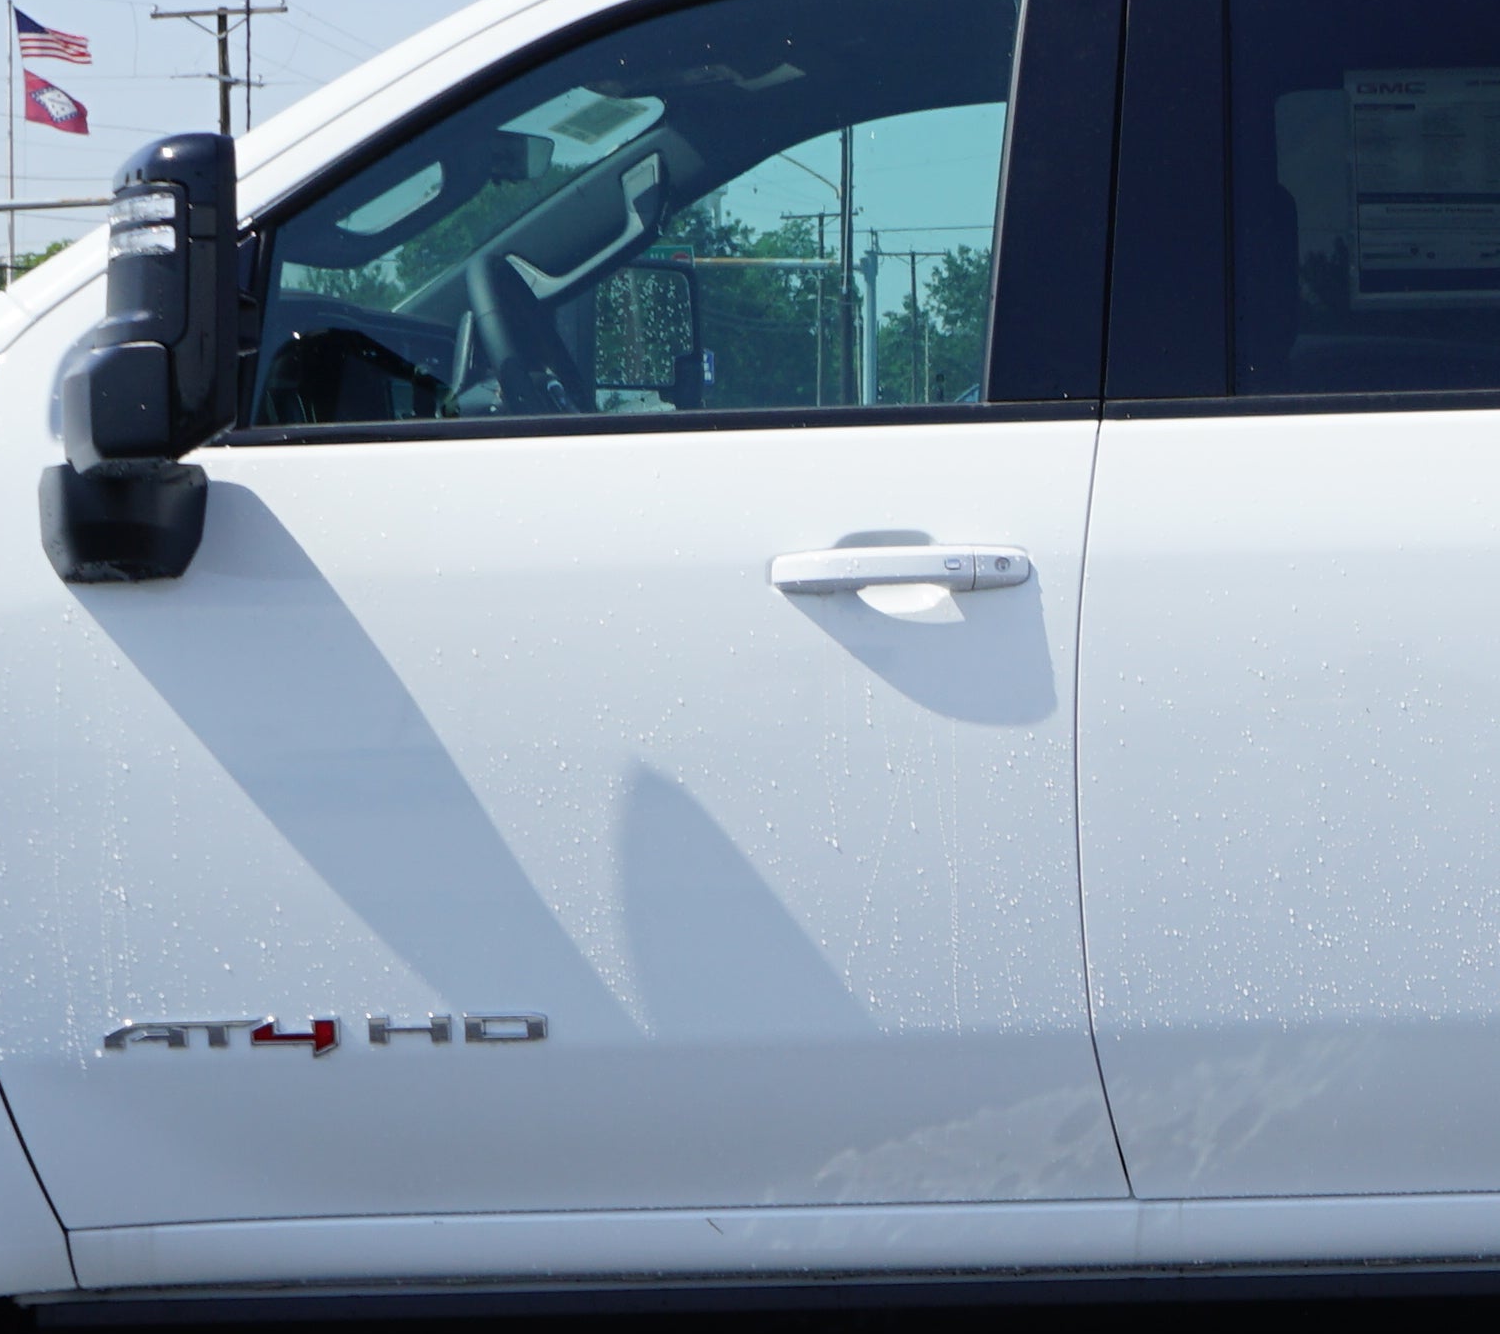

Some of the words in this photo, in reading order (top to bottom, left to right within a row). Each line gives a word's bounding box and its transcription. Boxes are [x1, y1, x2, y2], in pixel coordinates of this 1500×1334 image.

[1356, 80, 1426, 95] GMC
[104, 1016, 341, 1059] AT4
[368, 1012, 547, 1045] HD
